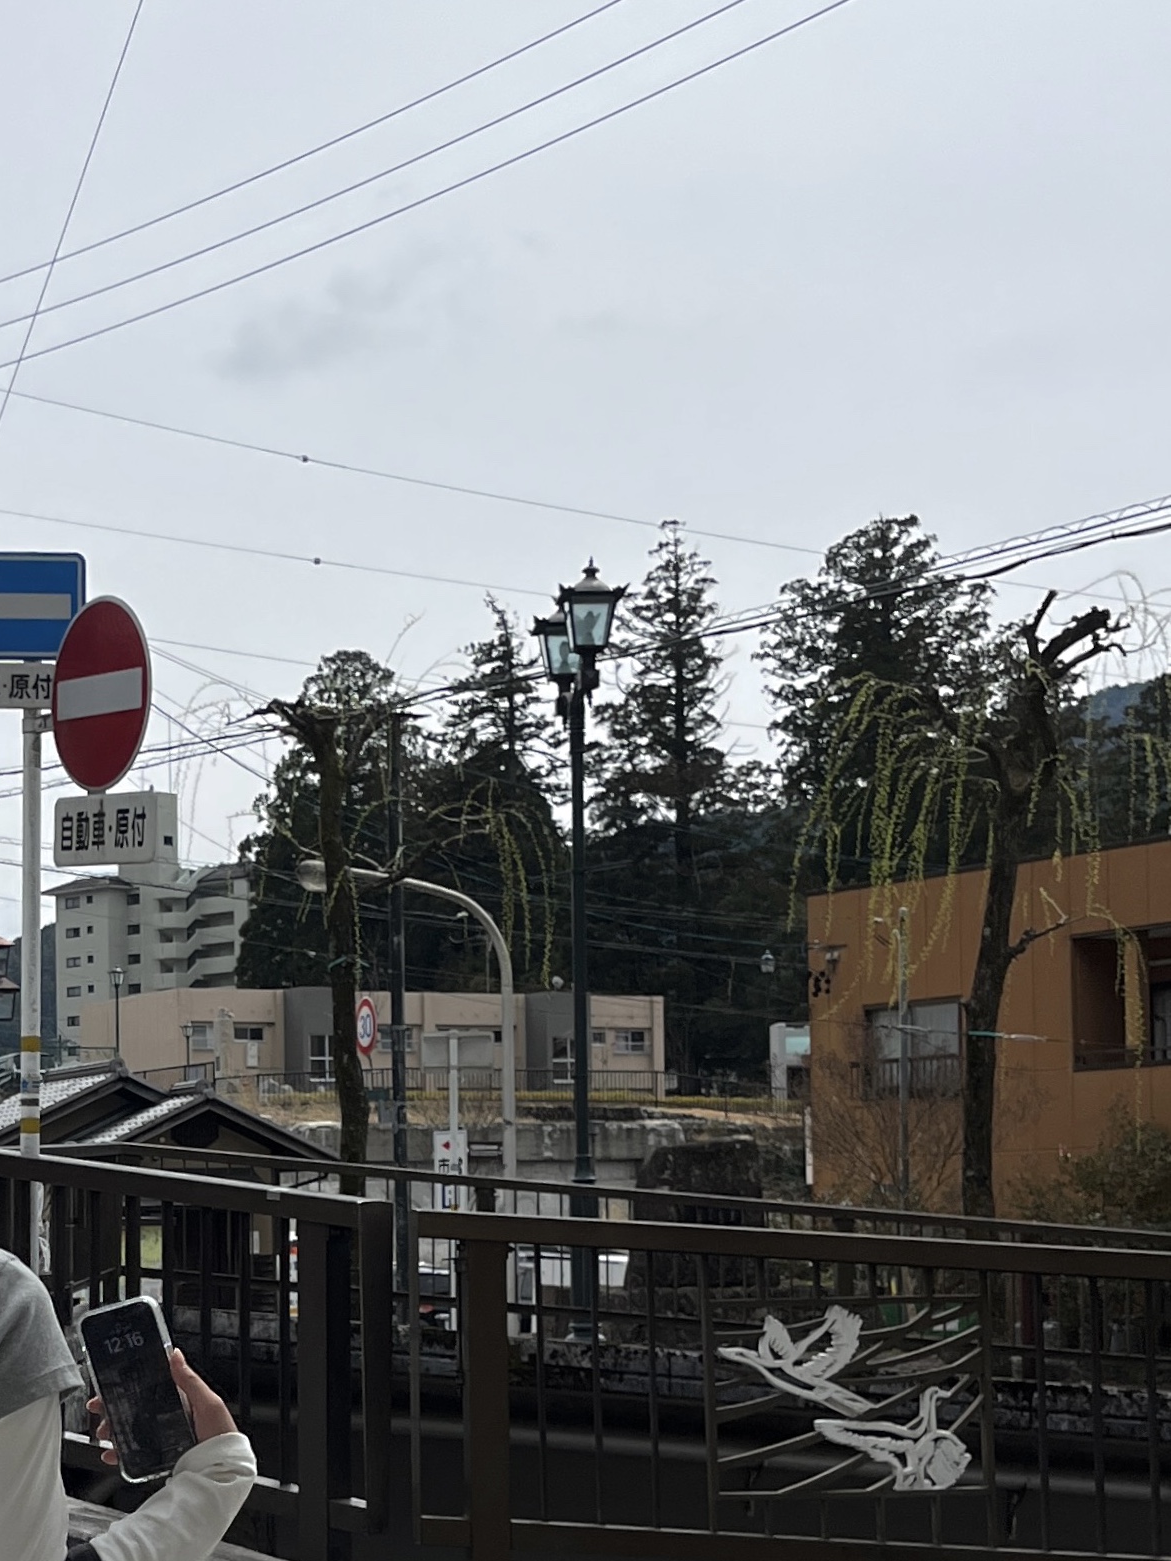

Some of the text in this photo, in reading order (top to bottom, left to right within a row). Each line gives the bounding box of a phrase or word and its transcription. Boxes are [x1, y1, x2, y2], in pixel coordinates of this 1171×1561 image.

[60, 807, 146, 851] 自動車・原付
[359, 1014, 372, 1038] 30
